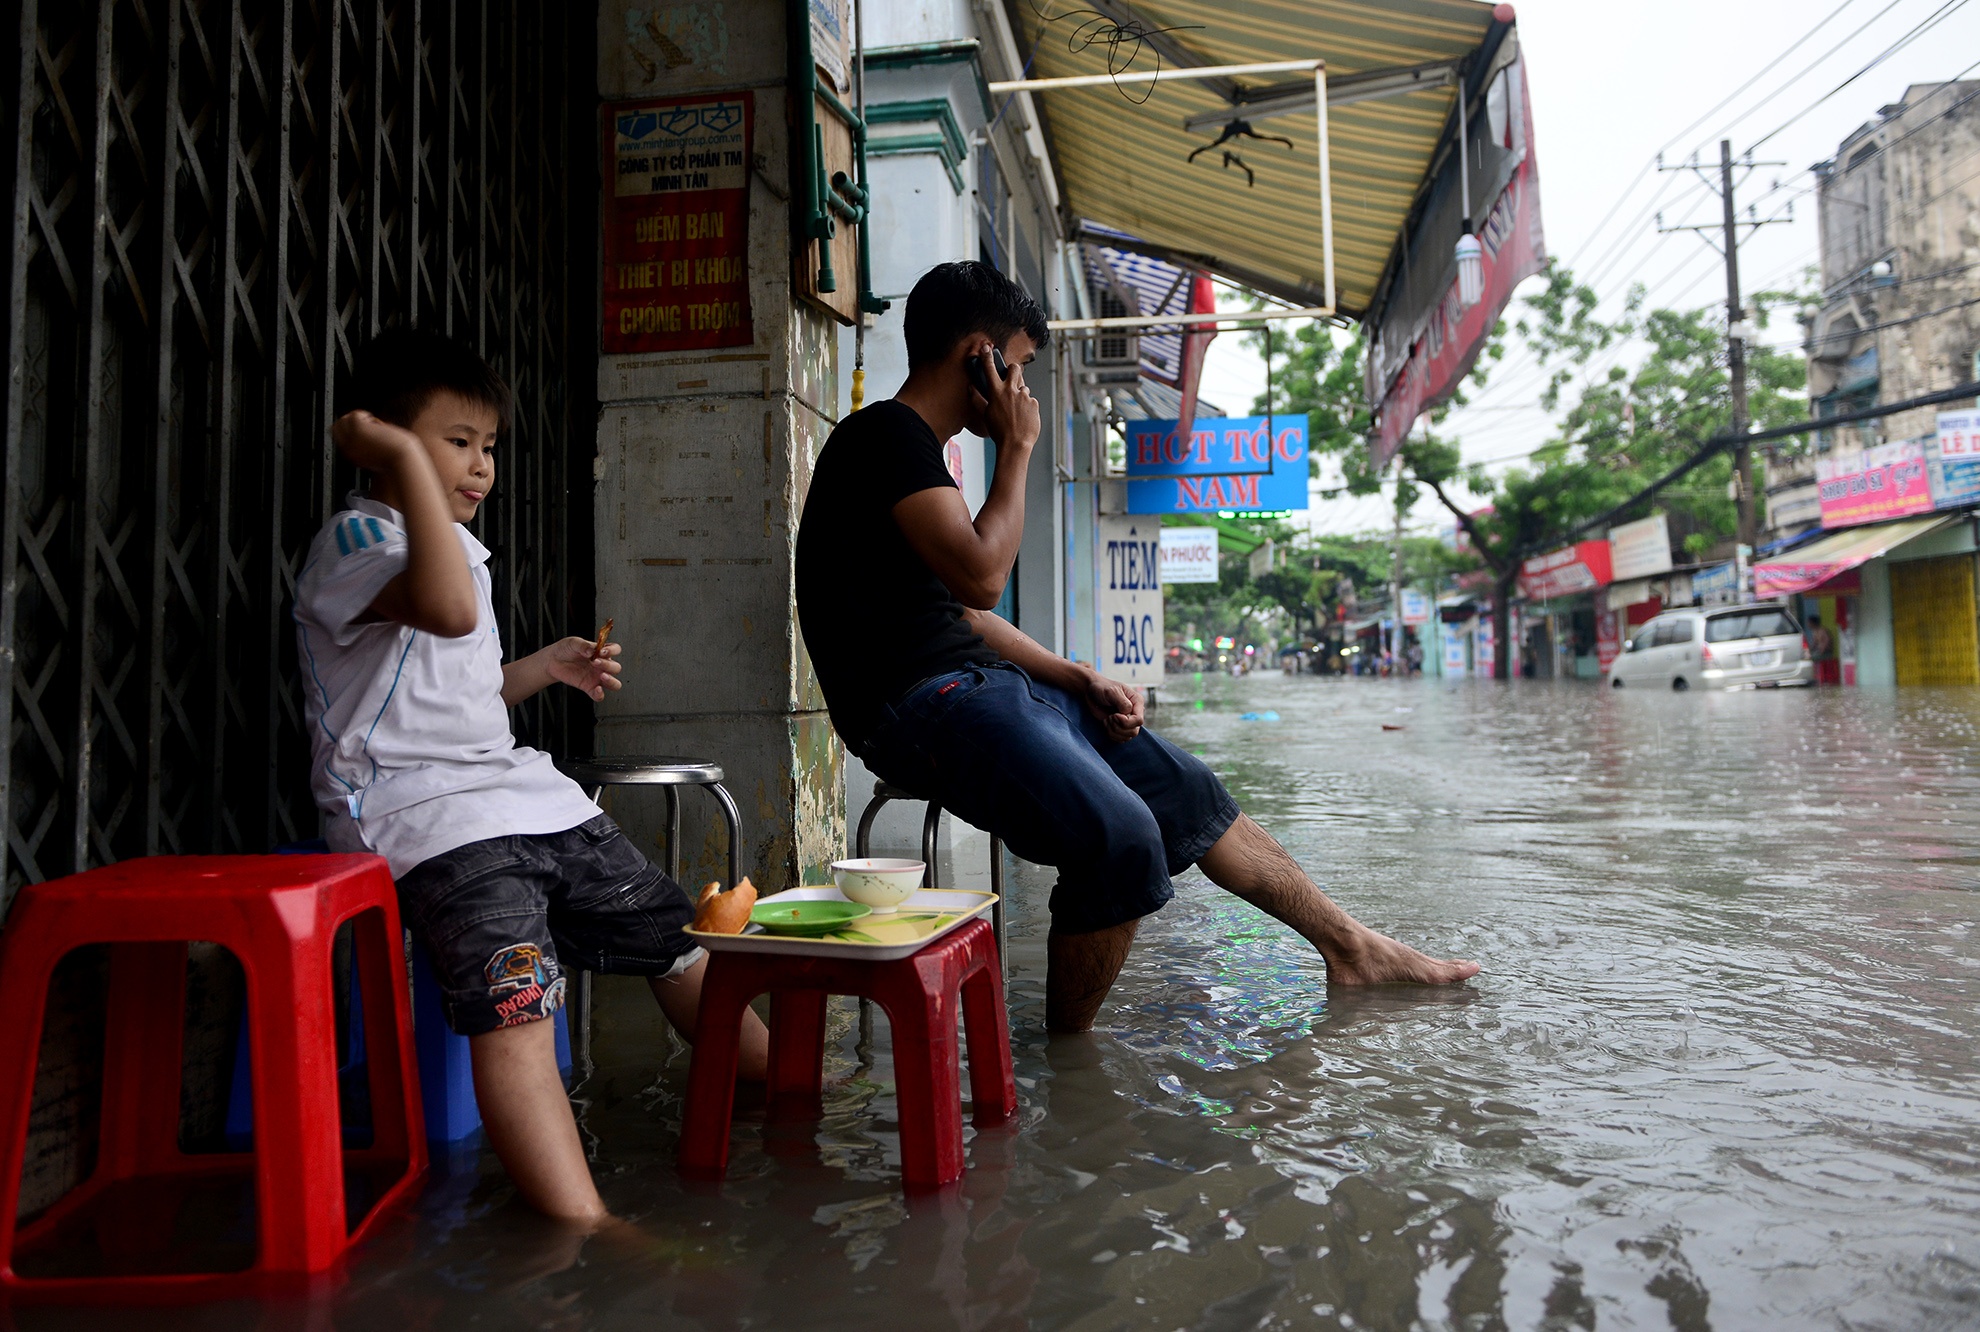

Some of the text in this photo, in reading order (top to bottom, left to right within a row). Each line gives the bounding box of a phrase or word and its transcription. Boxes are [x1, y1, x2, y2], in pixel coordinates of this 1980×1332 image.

[652, 156, 666, 171] TY
[723, 151, 742, 166] TM
[652, 175, 681, 191] MINH
[635, 207, 724, 243] ĐIỂM BÁN
[616, 251, 743, 290] THIẾT BỊ KHÓA
[619, 297, 740, 335] CHỐNG TRỘM
[1176, 475, 1262, 509] NAM
[1107, 526, 1158, 602] TIỆM
[1113, 614, 1154, 677] BẠC
